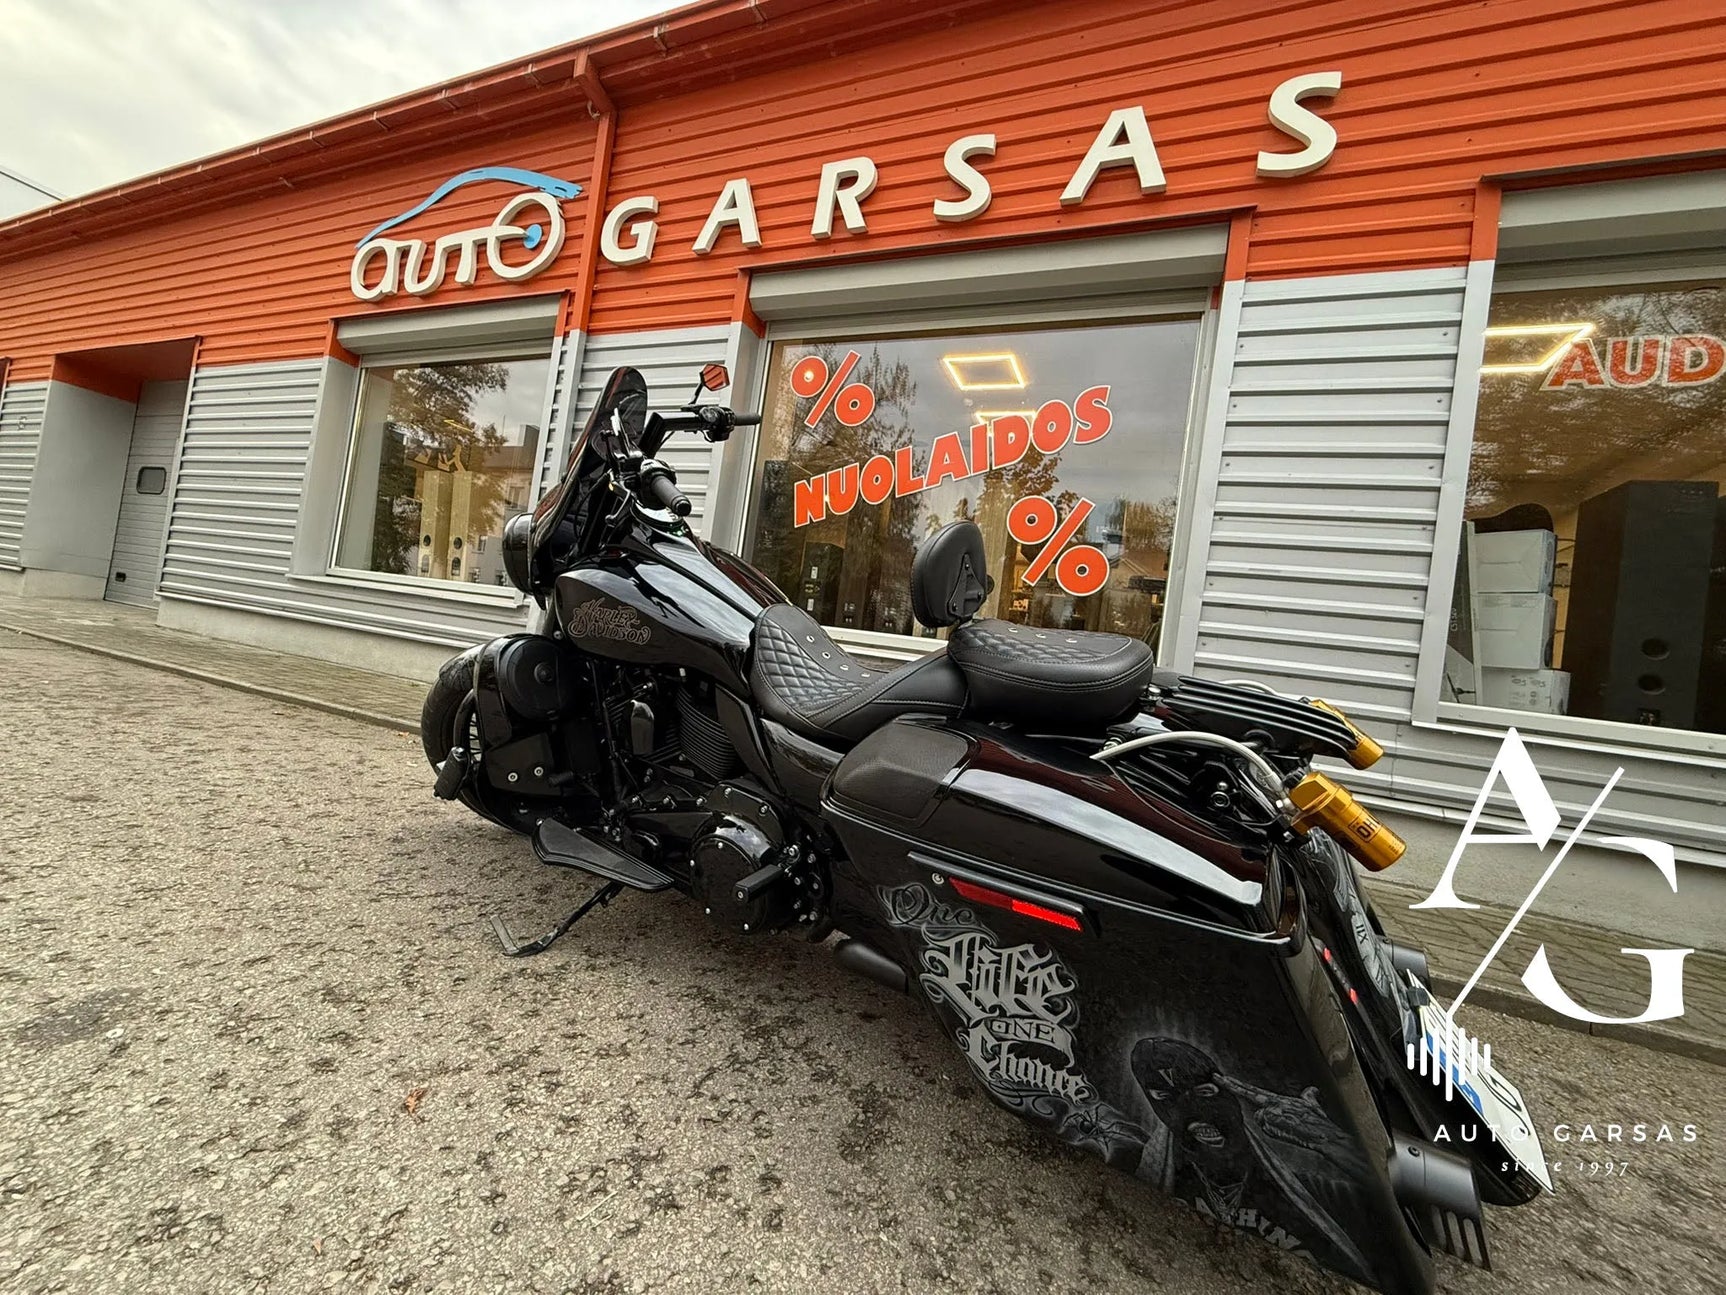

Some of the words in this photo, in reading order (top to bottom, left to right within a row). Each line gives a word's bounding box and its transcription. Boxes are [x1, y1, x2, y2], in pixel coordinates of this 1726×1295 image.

[600, 70, 1343, 267] GARSAS
[1539, 333, 1726, 391] AUD
[793, 384, 1113, 528] NUOLAIDOS
